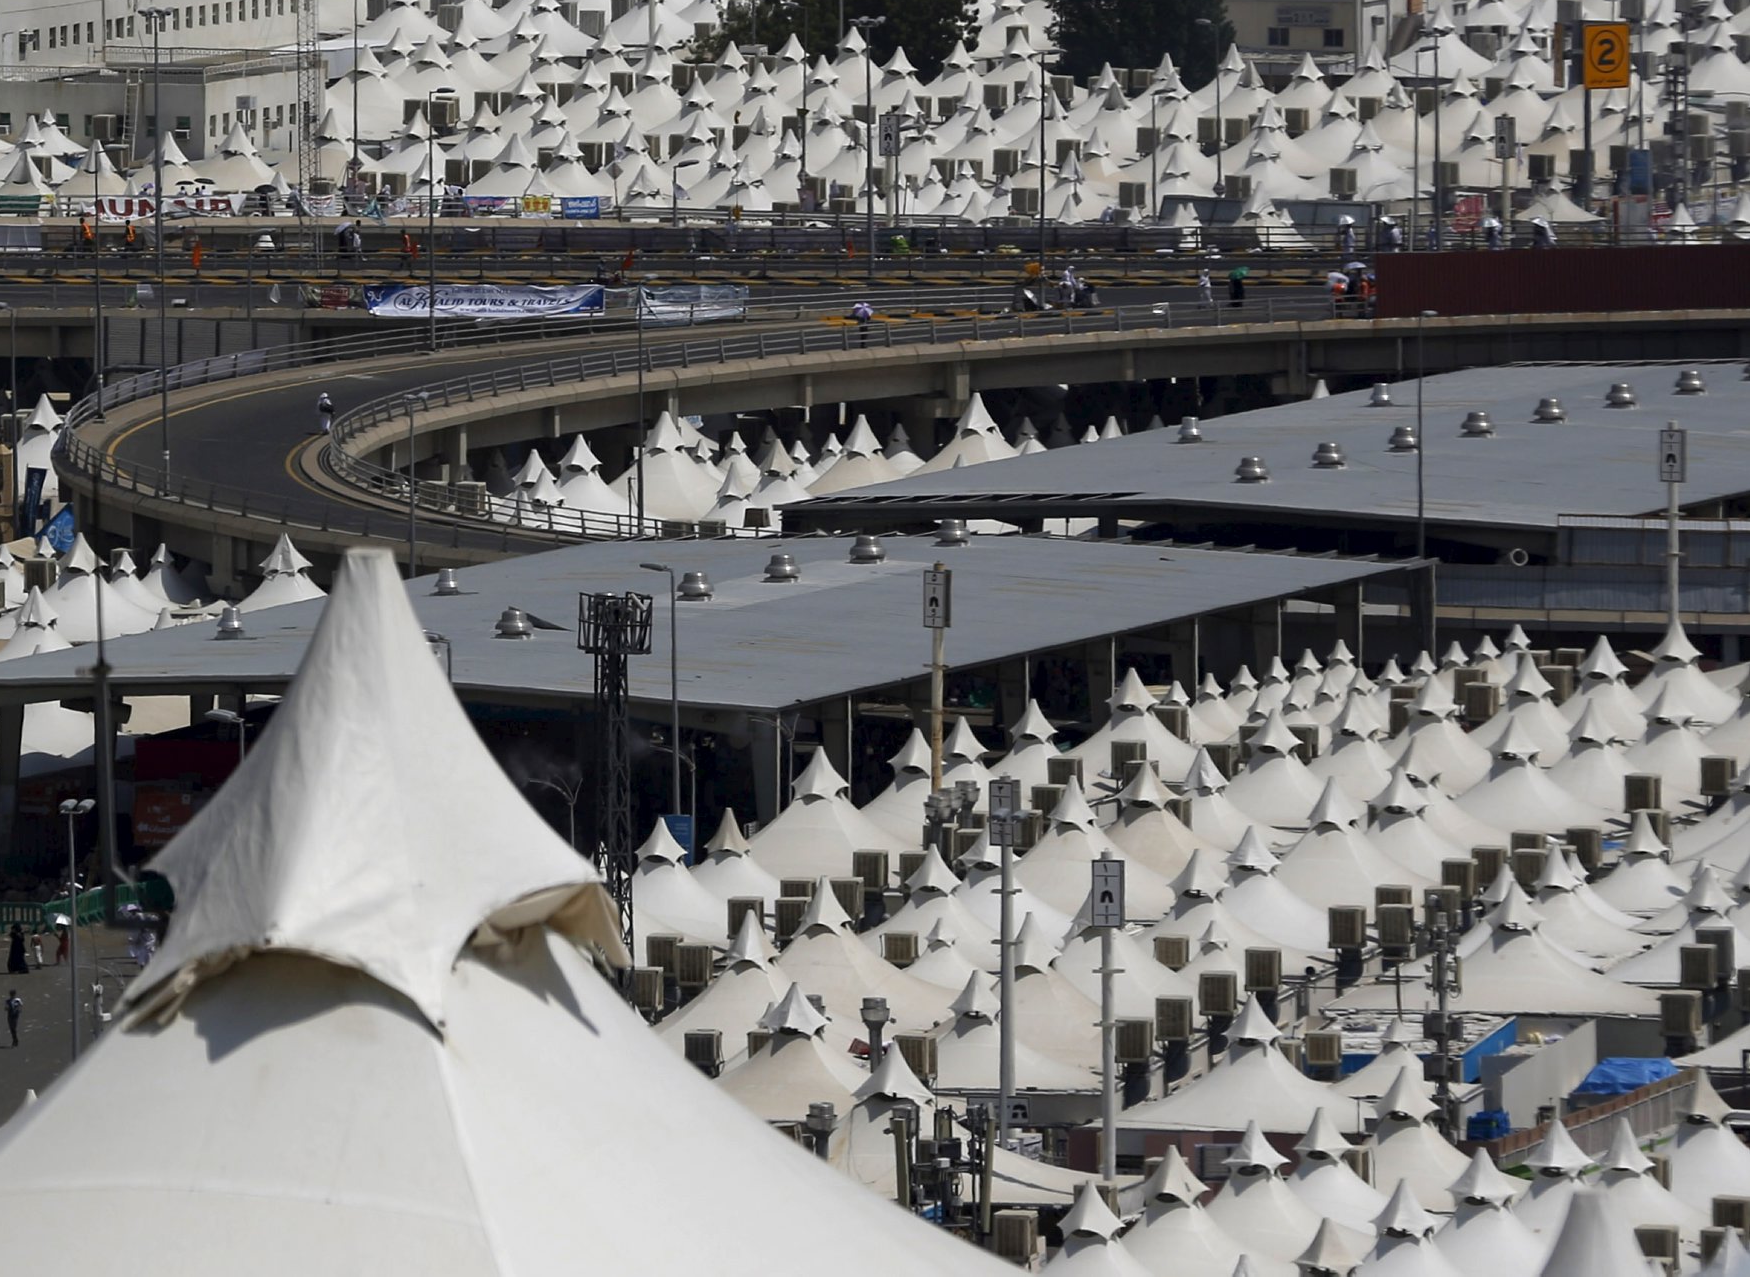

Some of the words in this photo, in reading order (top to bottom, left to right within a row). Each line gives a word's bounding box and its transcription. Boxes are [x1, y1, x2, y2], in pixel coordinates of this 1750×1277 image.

[1598, 38, 1615, 65] 2
[399, 298, 411, 306] AL
[468, 298, 504, 306] TOURS
[508, 298, 518, 306] &
[522, 298, 572, 306] TRAVELS
